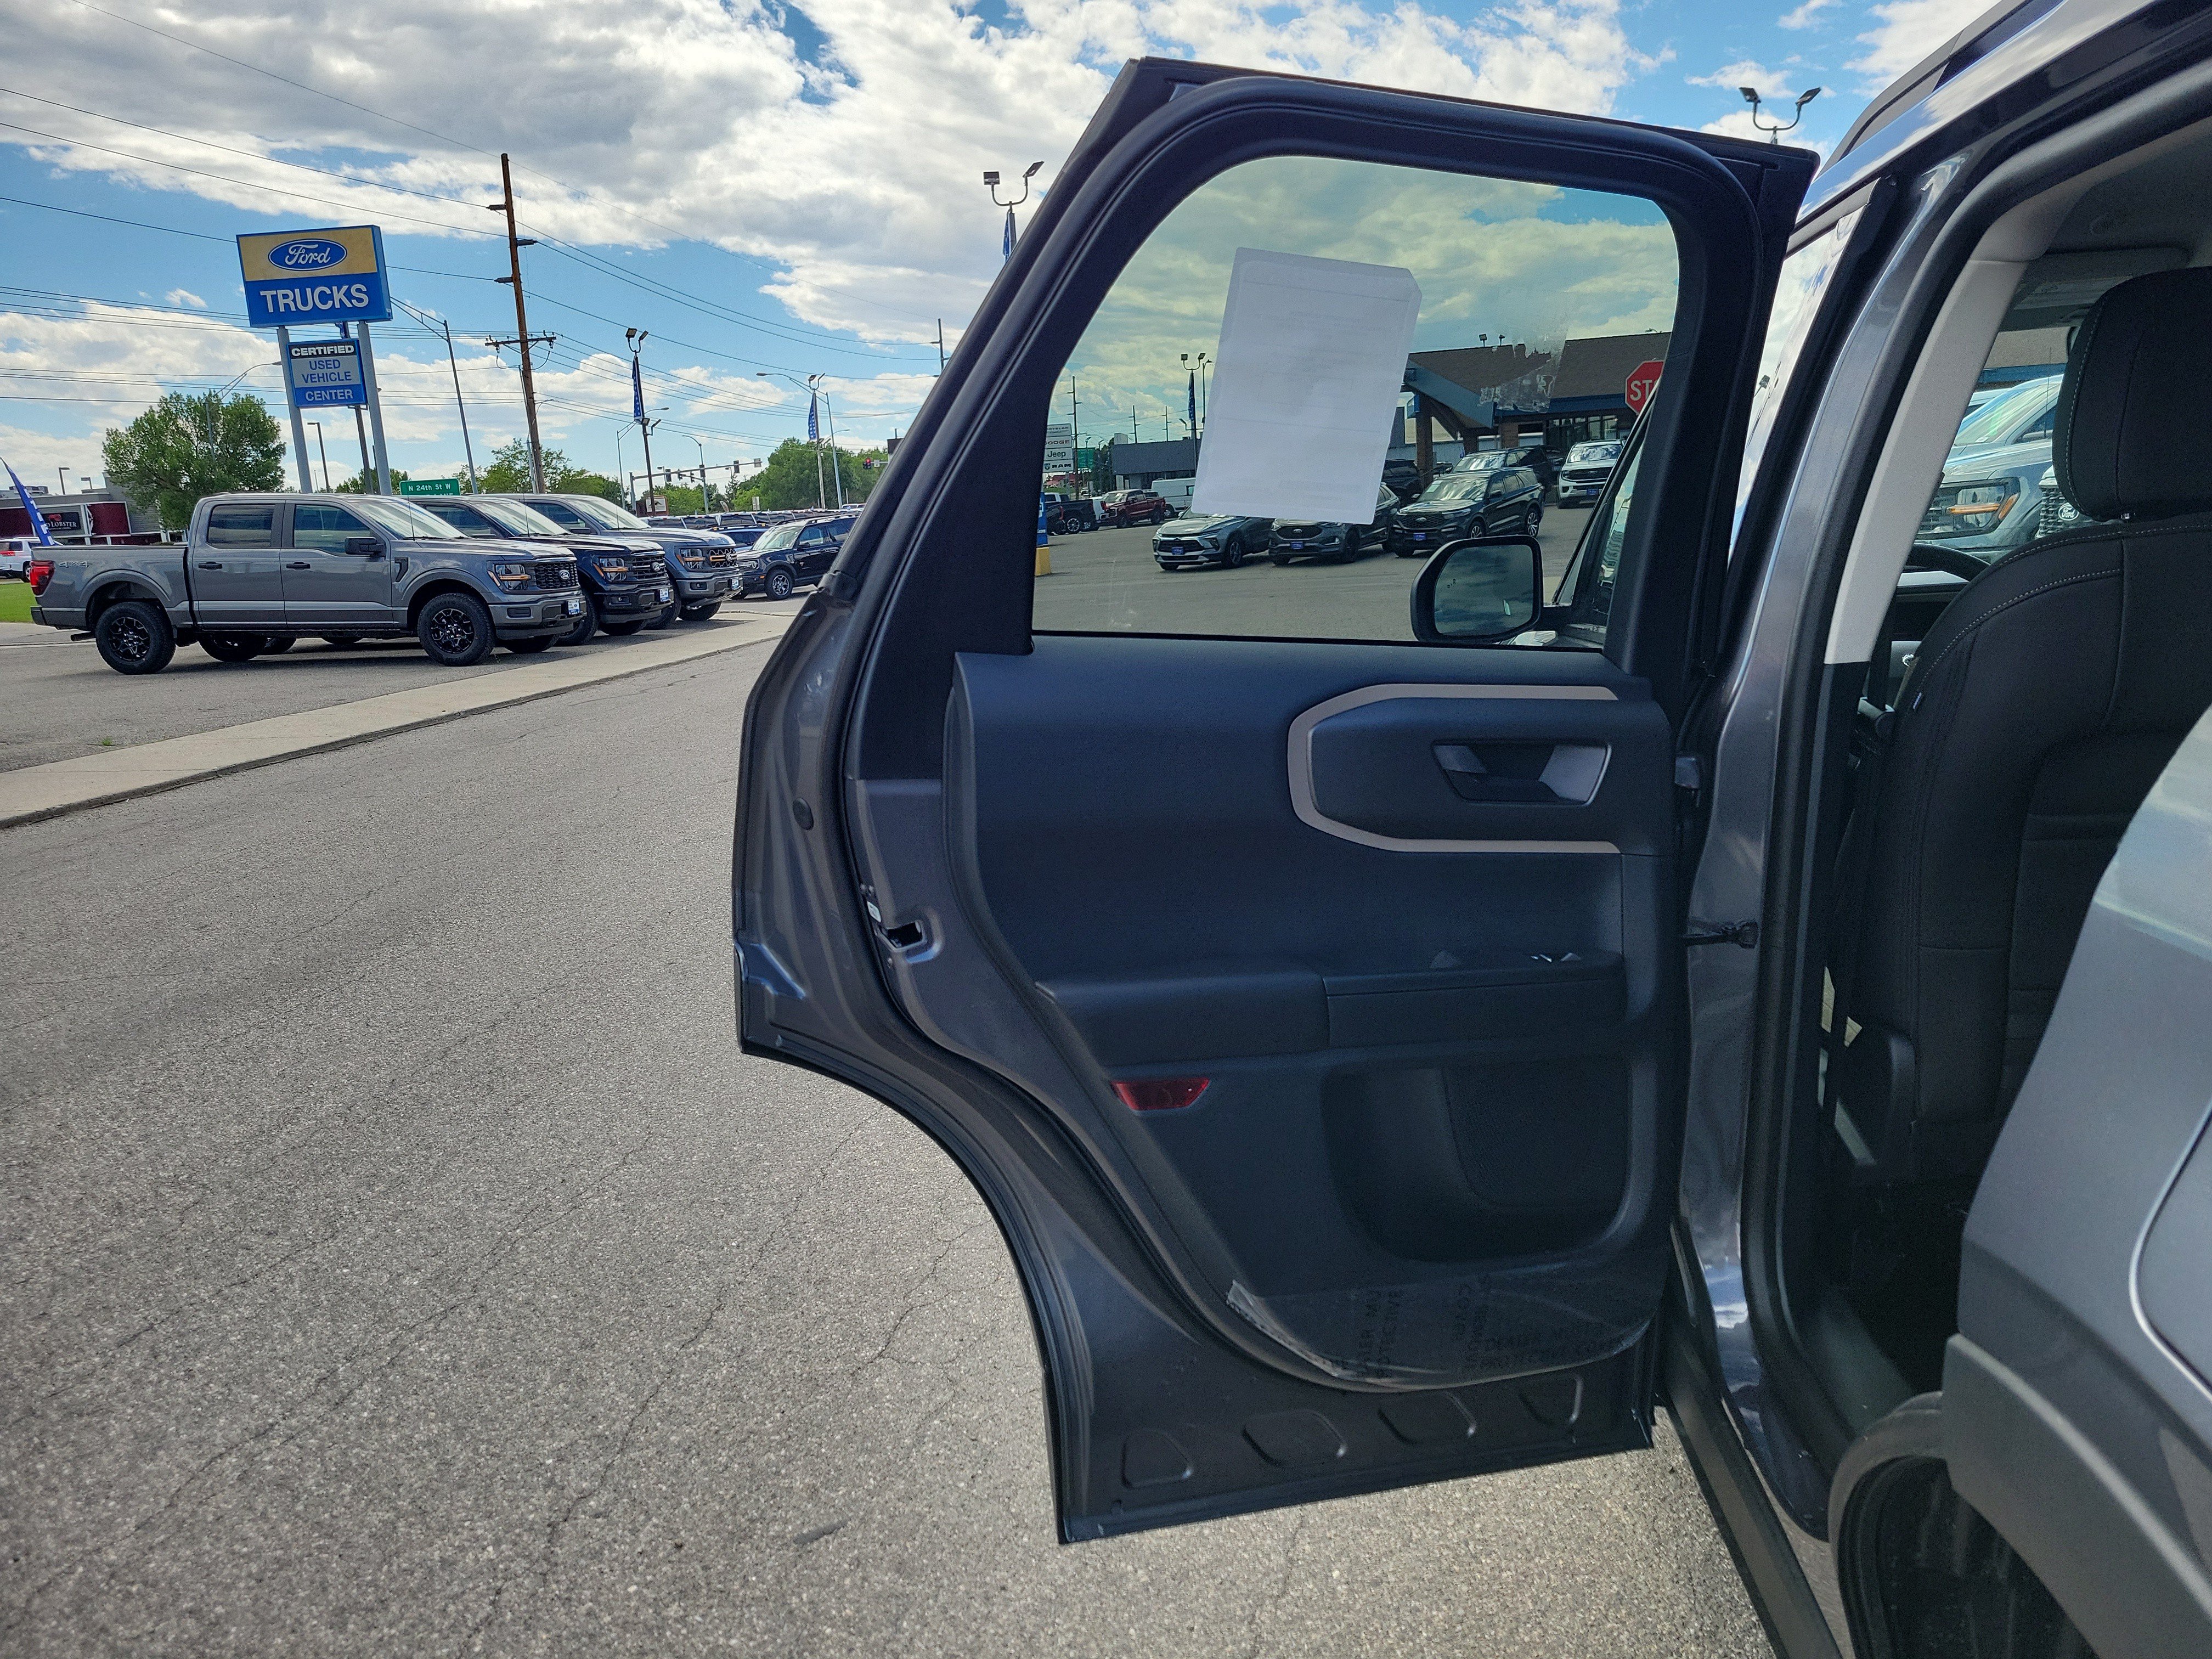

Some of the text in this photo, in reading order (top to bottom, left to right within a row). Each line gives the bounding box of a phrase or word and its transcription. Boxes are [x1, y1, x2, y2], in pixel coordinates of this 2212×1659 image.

[285, 244, 331, 265] Ford
[260, 284, 369, 313] TRUCKS
[291, 345, 354, 357] CERTIFIED
[309, 359, 341, 370] USED
[302, 371, 352, 383] VEHICLE
[305, 389, 353, 402] CENTER
[1630, 380, 1658, 401] ST
[2061, 507, 2075, 518] Ford
